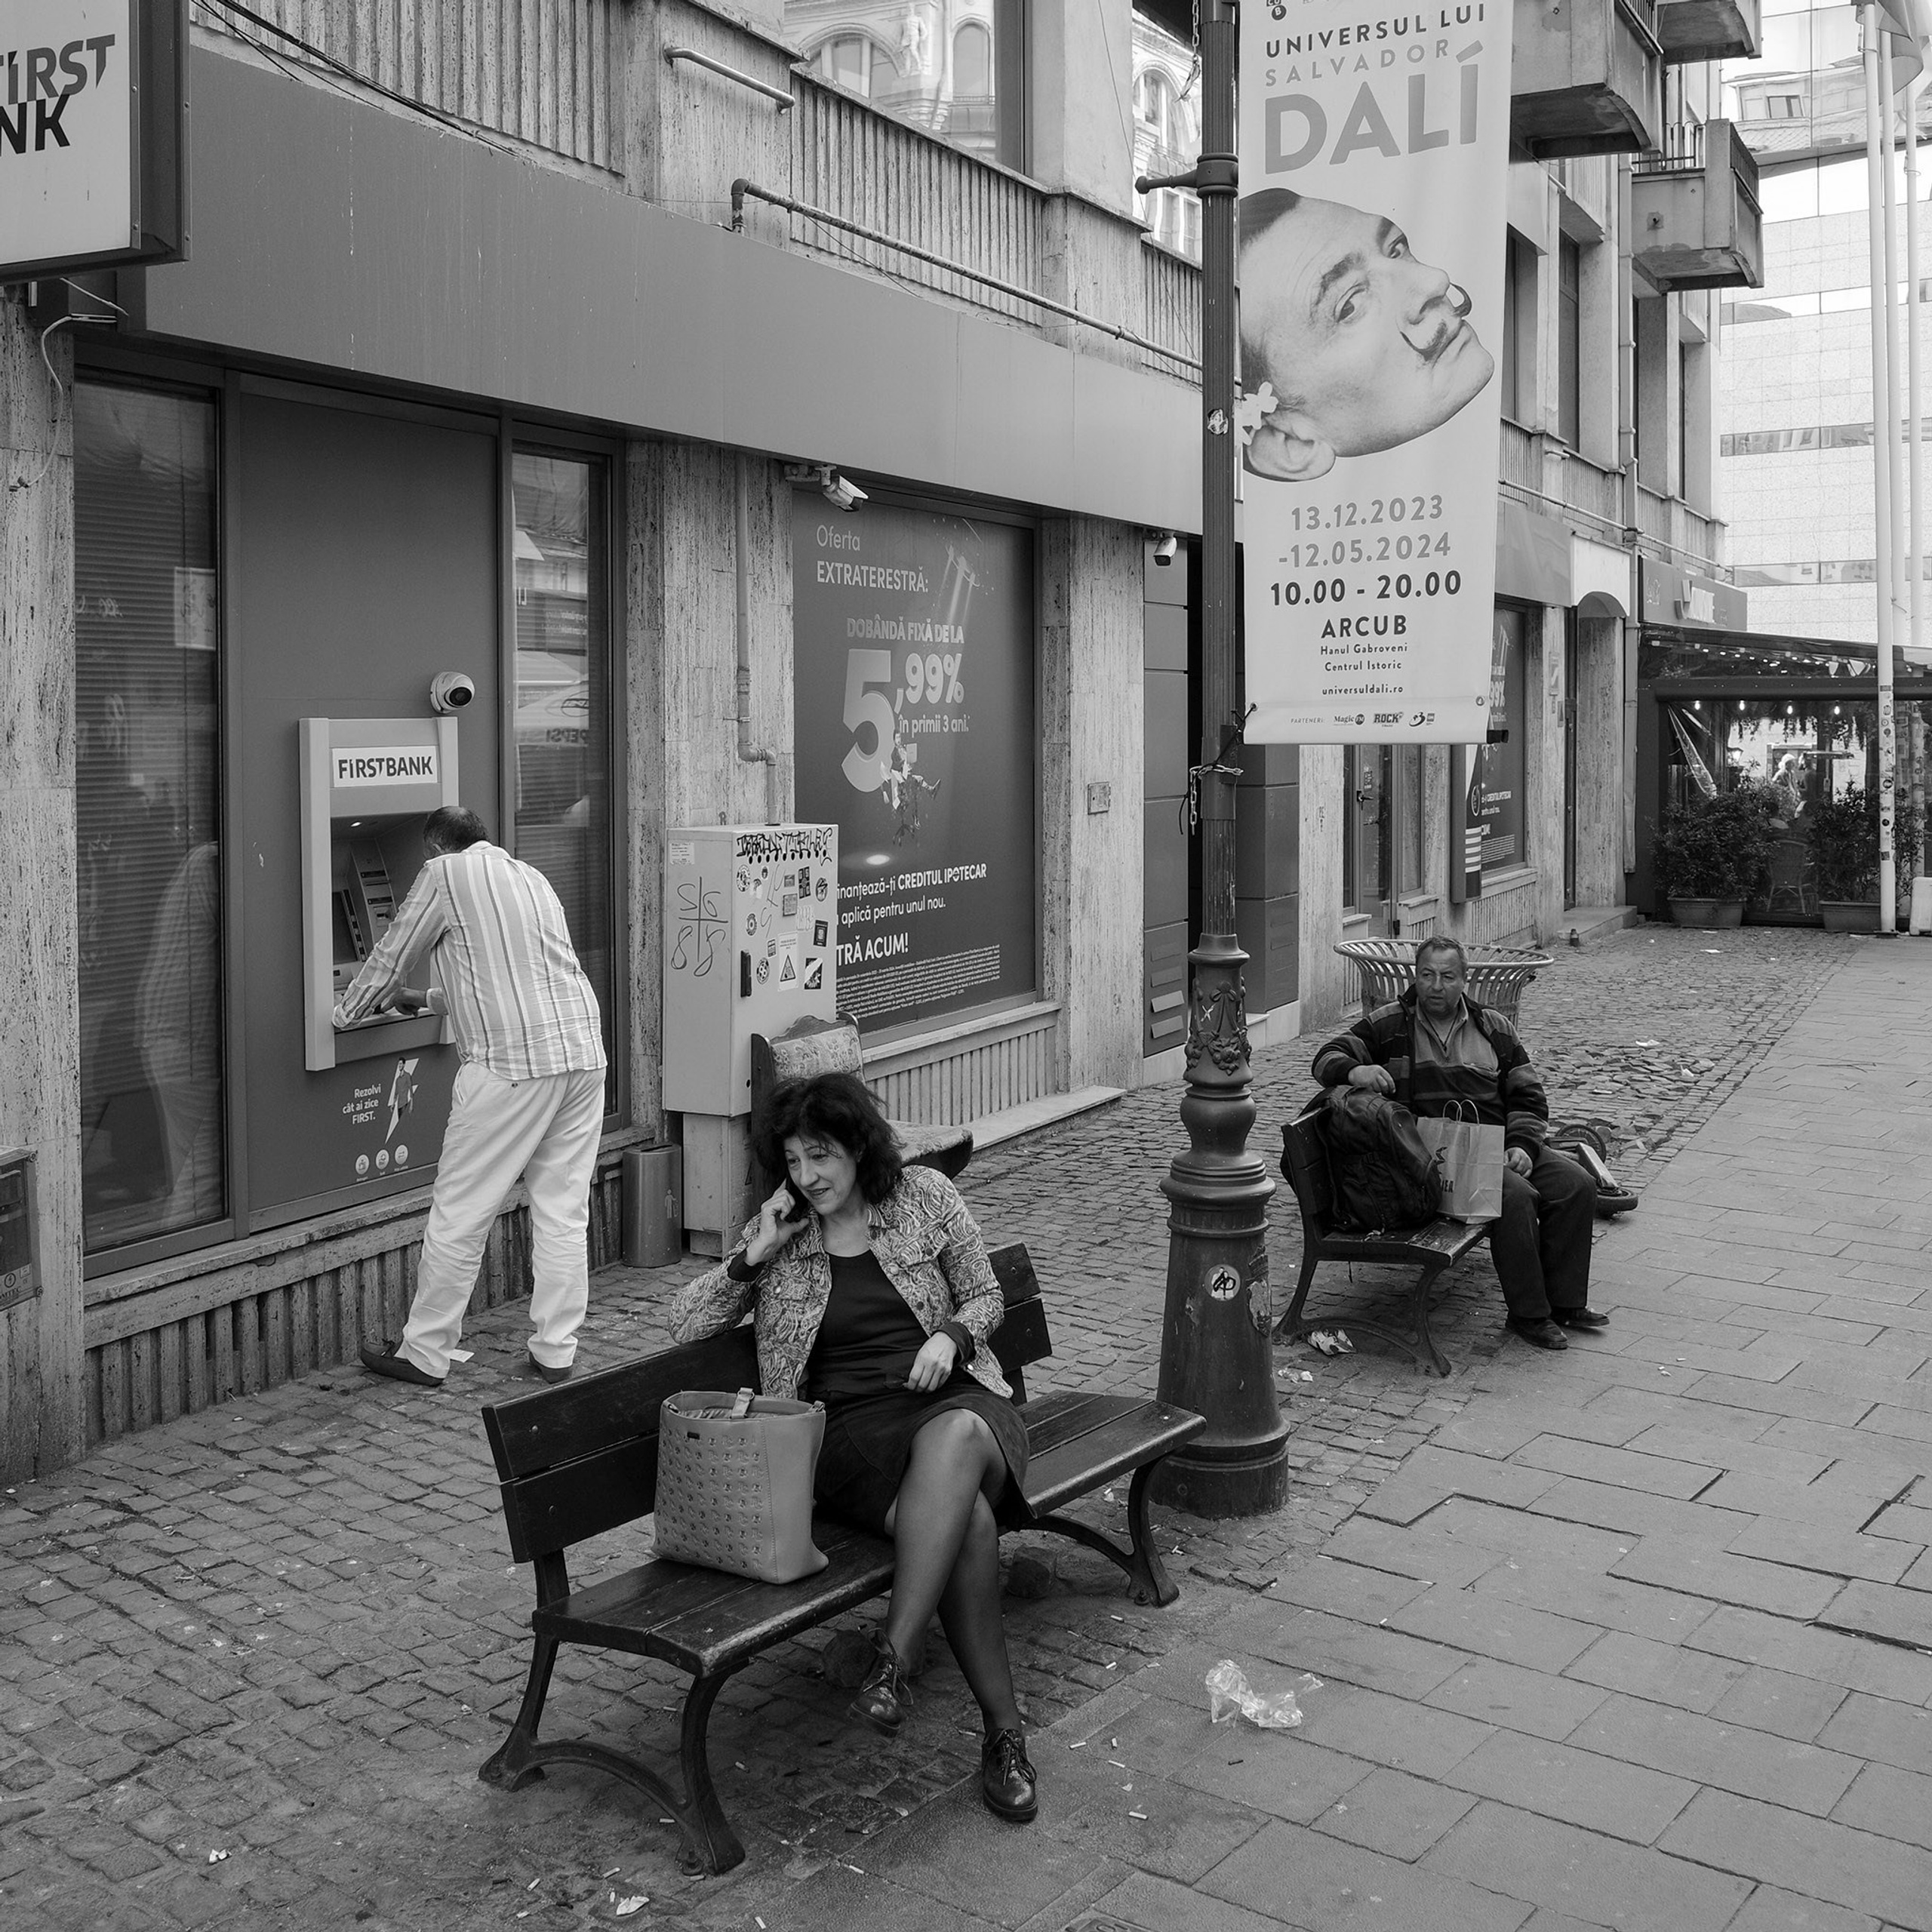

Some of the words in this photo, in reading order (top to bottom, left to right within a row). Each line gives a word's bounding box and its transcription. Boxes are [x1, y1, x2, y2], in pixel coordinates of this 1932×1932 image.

[1266, 15, 1427, 58] UNIVERSUL
[1440, 3, 1484, 28] LUI
[0, 34, 115, 105] IRST
[1266, 38, 1449, 87] SALVADOR
[1265, 39, 1484, 175] DALÍ
[1291, 494, 1443, 531] 13.12.2023
[817, 525, 860, 551] Oferta
[1278, 531, 1451, 568] -12.05.2024
[817, 560, 928, 592] EXTRATERESTRĂ:
[1271, 578, 1346, 605] 10.00
[1377, 570, 1461, 599] 20.00
[847, 614, 906, 641] DOBÂNDĂ
[908, 618, 934, 642] FIXĂ
[934, 624, 949, 643] DE
[950, 625, 964, 644] LA
[1321, 614, 1407, 639] ARCUB
[1321, 645, 1349, 656] Hanul
[1353, 642, 1408, 654] Gabroveni
[1324, 660, 1363, 672] Centrul
[1367, 660, 1402, 670] Istoric
[1322, 684, 1404, 696] universuldali.ro
[898, 714, 909, 733] în
[912, 714, 941, 738] primii
[943, 715, 949, 733] 3
[1334, 715, 1355, 724] Magic
[1373, 712, 1399, 724] ROCK
[338, 755, 433, 780] FIRSTBANK
[897, 869, 943, 891] CREDITUL
[943, 863, 987, 884] IPOTECAR
[841, 905, 871, 928] aplică
[873, 902, 904, 924] pentru
[906, 895, 926, 914] unul
[927, 896, 946, 912] nou.
[864, 932, 909, 961] ACUM!
[354, 1084, 381, 1098] Rezolvi
[352, 1111, 376, 1124] FIRST.
[355, 1100, 363, 1111] ai
[364, 1099, 379, 1109] zice
